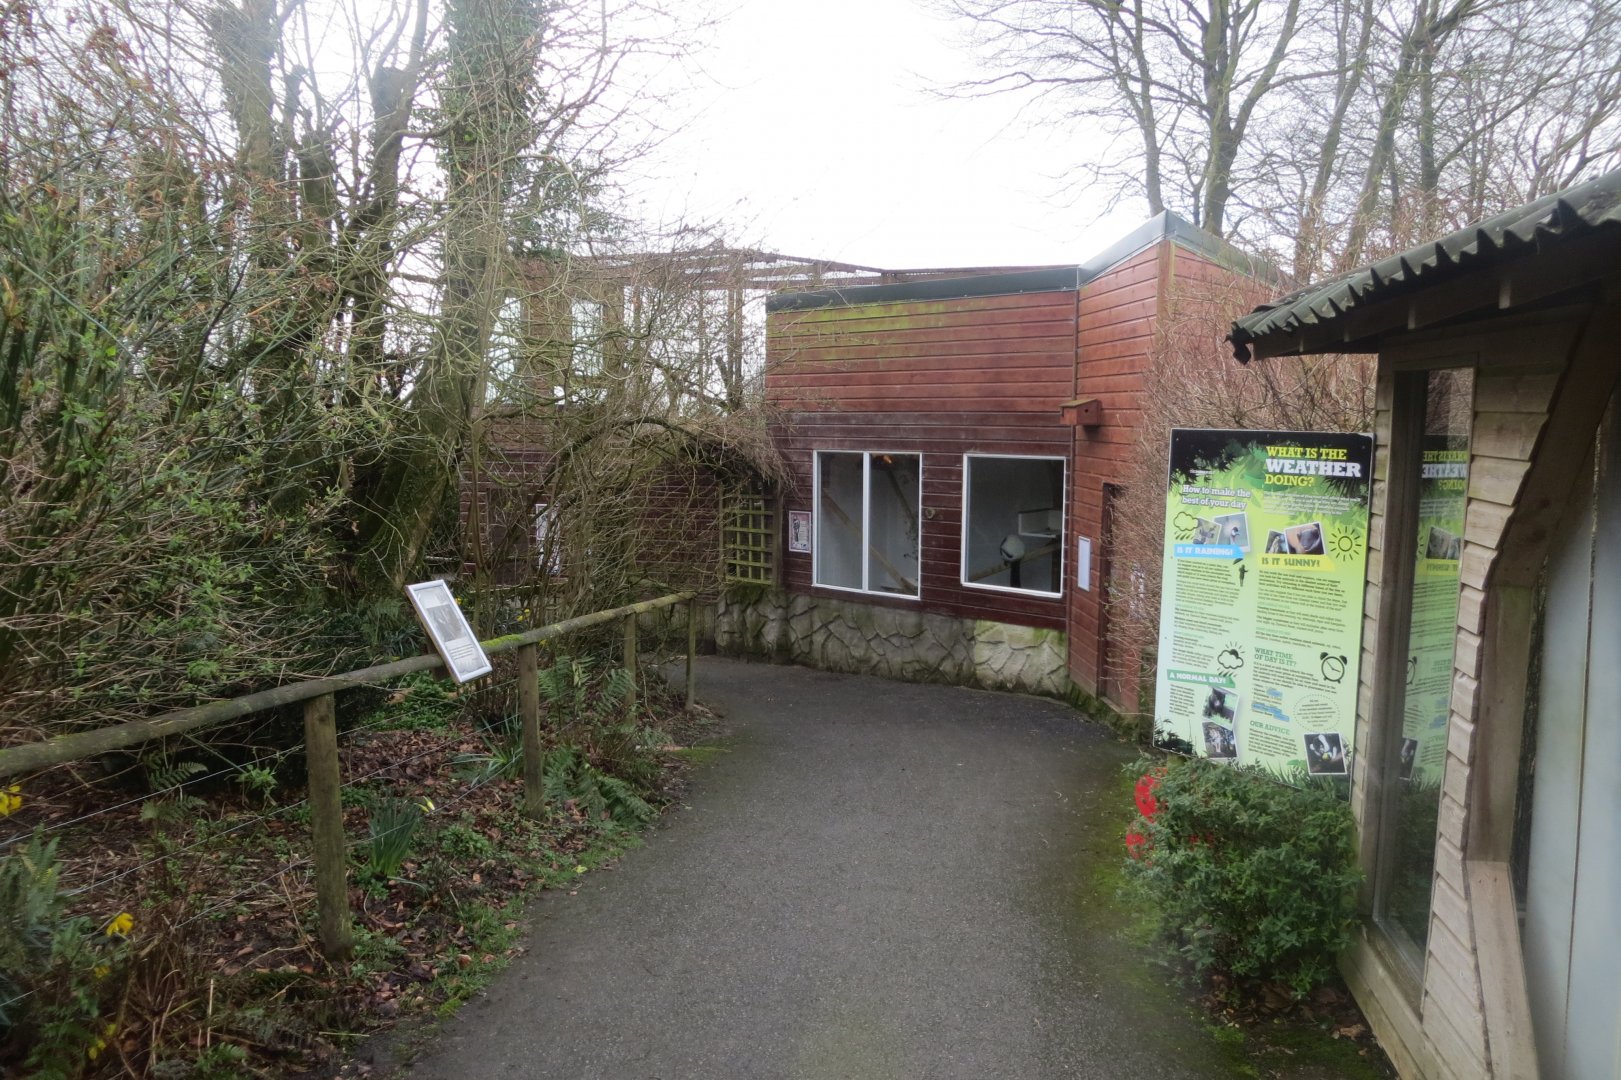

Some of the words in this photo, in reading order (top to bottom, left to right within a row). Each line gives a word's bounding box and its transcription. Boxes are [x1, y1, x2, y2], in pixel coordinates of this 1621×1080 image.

[1266, 446, 1303, 458] WHAT
[1305, 447, 1318, 459] IS
[1320, 448, 1347, 460] THE
[1265, 458, 1362, 478] WEATHER
[1264, 473, 1314, 487] DOING?
[1183, 484, 1201, 494] How
[1202, 486, 1210, 495] to
[1211, 487, 1235, 497] make
[1237, 488, 1251, 498] the
[1182, 495, 1199, 505] best
[1200, 497, 1209, 506] of
[1208, 498, 1229, 508] your
[1230, 499, 1247, 510] day
[1261, 557, 1269, 565] IS
[1271, 557, 1280, 566] IT
[1254, 647, 1274, 657] WHAT
[1275, 651, 1293, 660] TIME
[1254, 653, 1263, 661] OF
[1264, 655, 1279, 664] DAY
[1176, 672, 1207, 683] NORMAL
[1249, 720, 1265, 729] OUR
